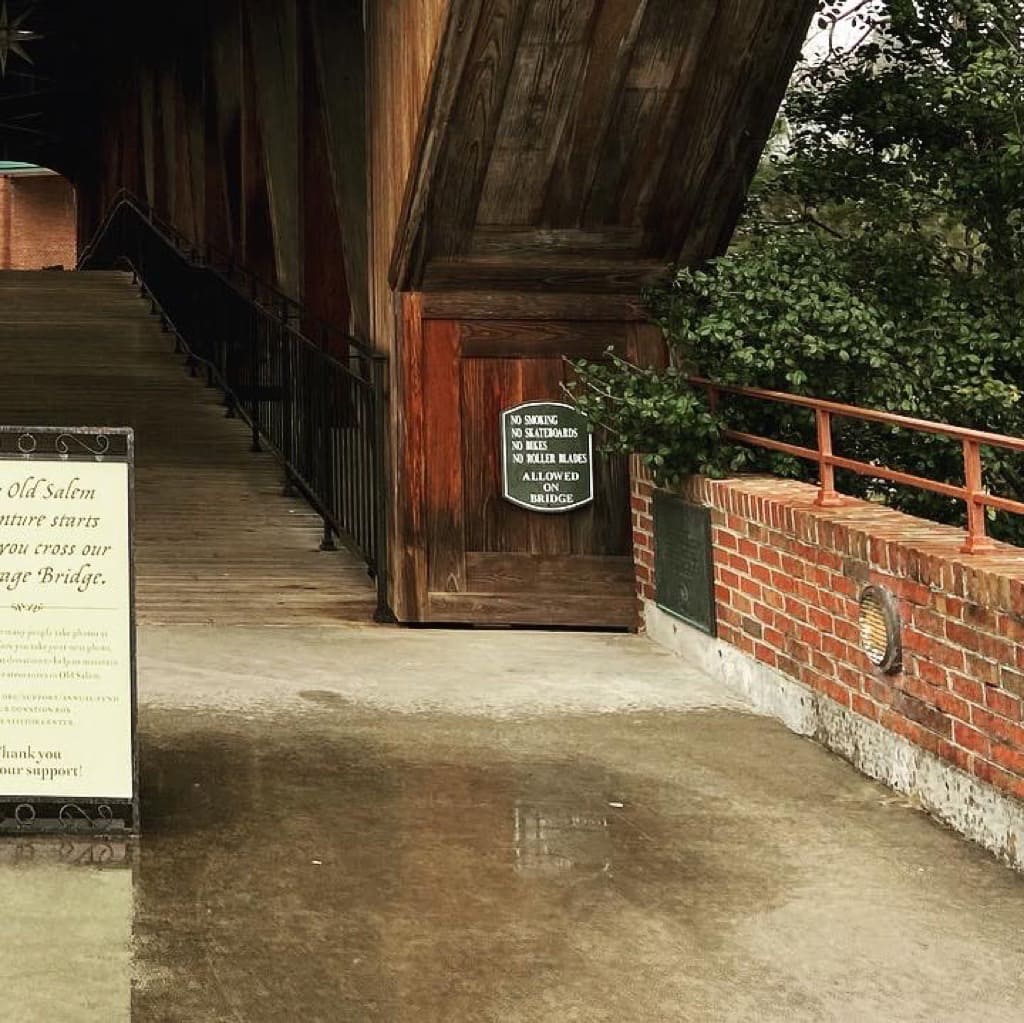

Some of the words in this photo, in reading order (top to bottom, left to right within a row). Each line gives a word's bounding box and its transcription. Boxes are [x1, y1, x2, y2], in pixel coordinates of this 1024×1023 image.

[510, 415, 522, 425] NO
[524, 415, 558, 425] SMOKING
[511, 428, 523, 438] NO
[524, 428, 578, 438] SKATEBOARDS
[511, 440, 523, 451] NO
[526, 440, 548, 451] BIKES
[512, 454, 524, 464] NO
[526, 454, 556, 464] ROLLER
[558, 454, 588, 464] BLADES
[522, 471, 580, 481] ALLOWED
[7, 476, 46, 499] Old
[42, 477, 96, 500] Salem
[543, 483, 559, 492] ON
[530, 493, 574, 503] BRIDGE
[51, 513, 100, 528] starts
[34, 543, 76, 556] cross
[81, 544, 112, 556] our
[37, 563, 108, 593] Bridge.
[36, 749, 62, 764] you
[26, 765, 83, 781] support!
